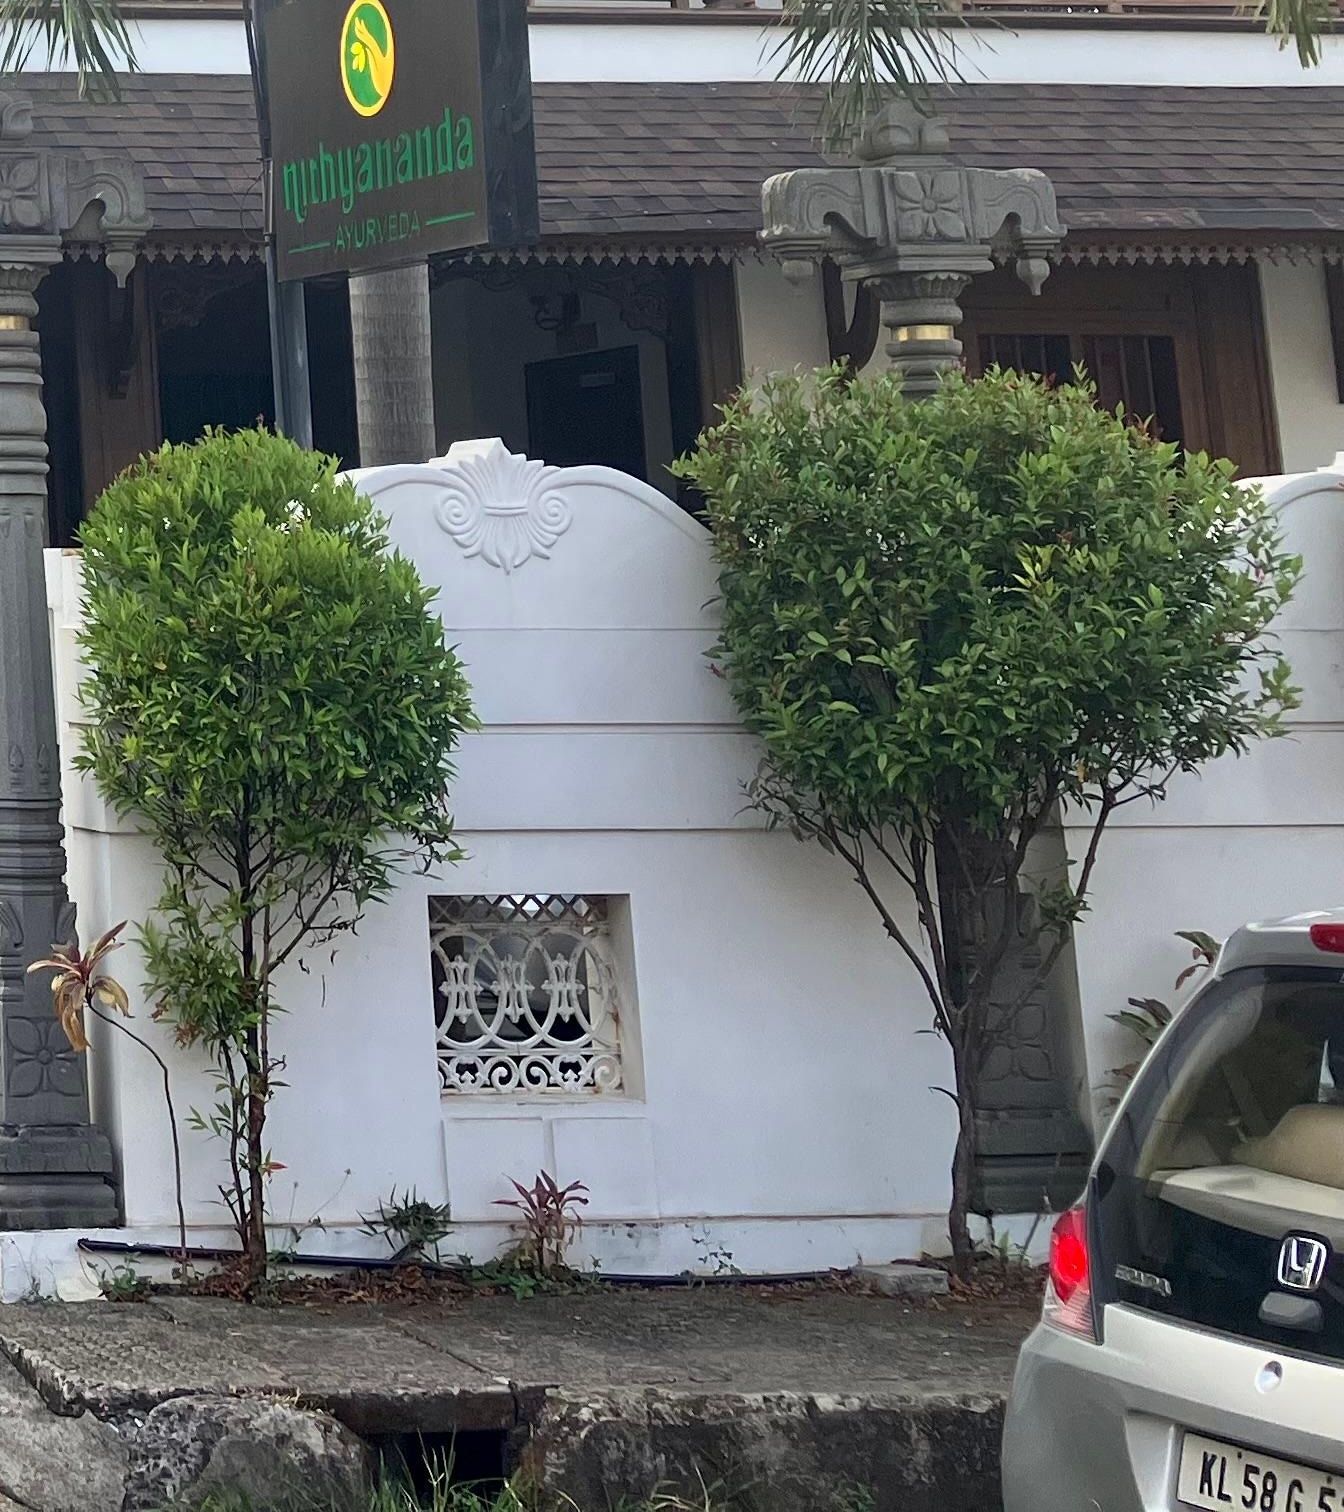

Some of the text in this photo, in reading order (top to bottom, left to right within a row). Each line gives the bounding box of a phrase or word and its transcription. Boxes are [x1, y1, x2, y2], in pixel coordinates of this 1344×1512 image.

[335, 210, 421, 254] AYURVEDA
[1199, 1450, 1232, 1503] KL
[1241, 1463, 1277, 1512] 58
